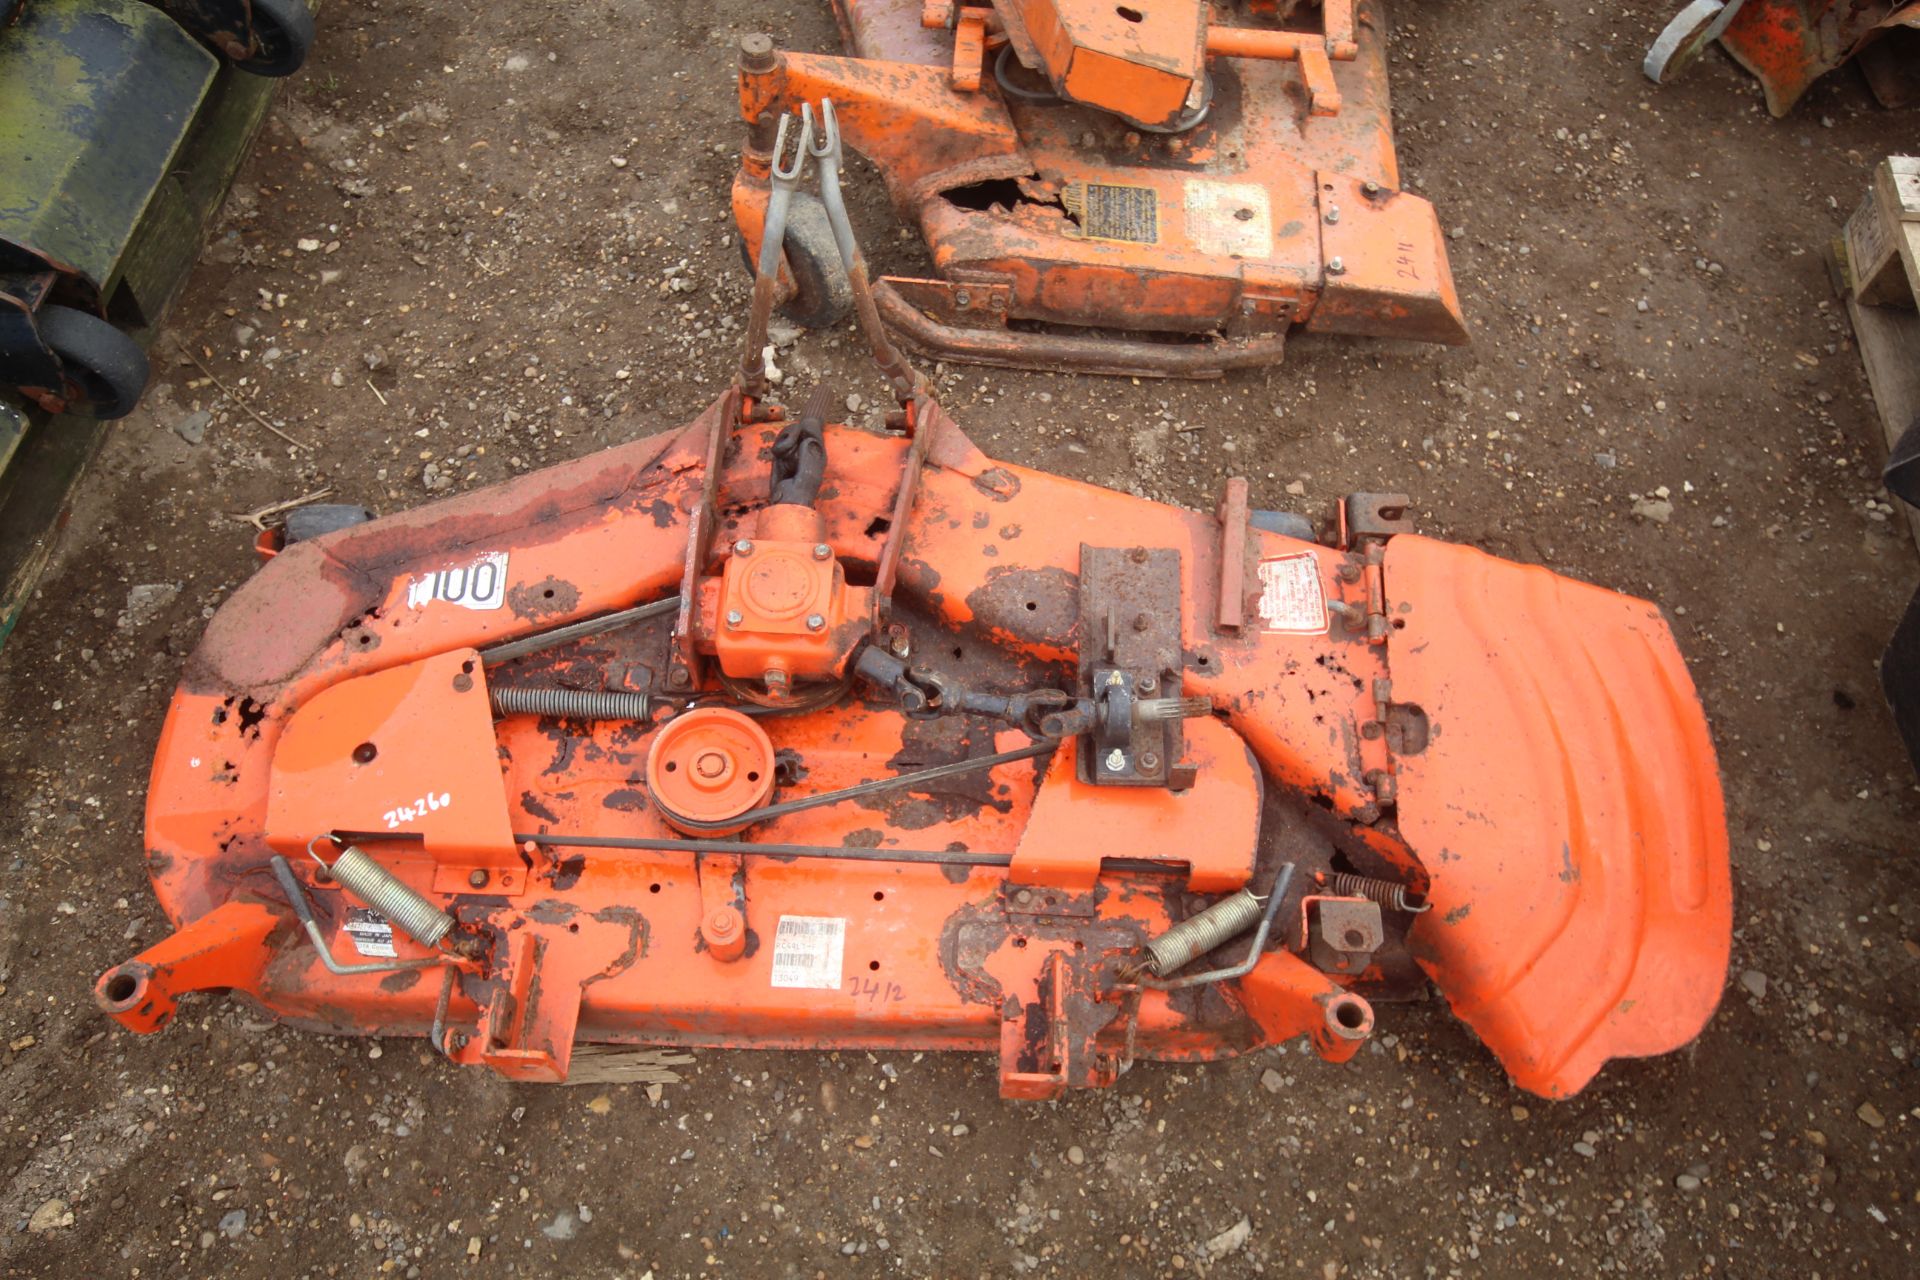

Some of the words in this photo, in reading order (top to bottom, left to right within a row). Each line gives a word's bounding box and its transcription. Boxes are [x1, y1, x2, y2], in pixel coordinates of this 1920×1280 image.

[1396, 242, 1420, 280] 2411
[383, 791, 451, 829] 24260
[848, 976, 906, 1002] 2412
